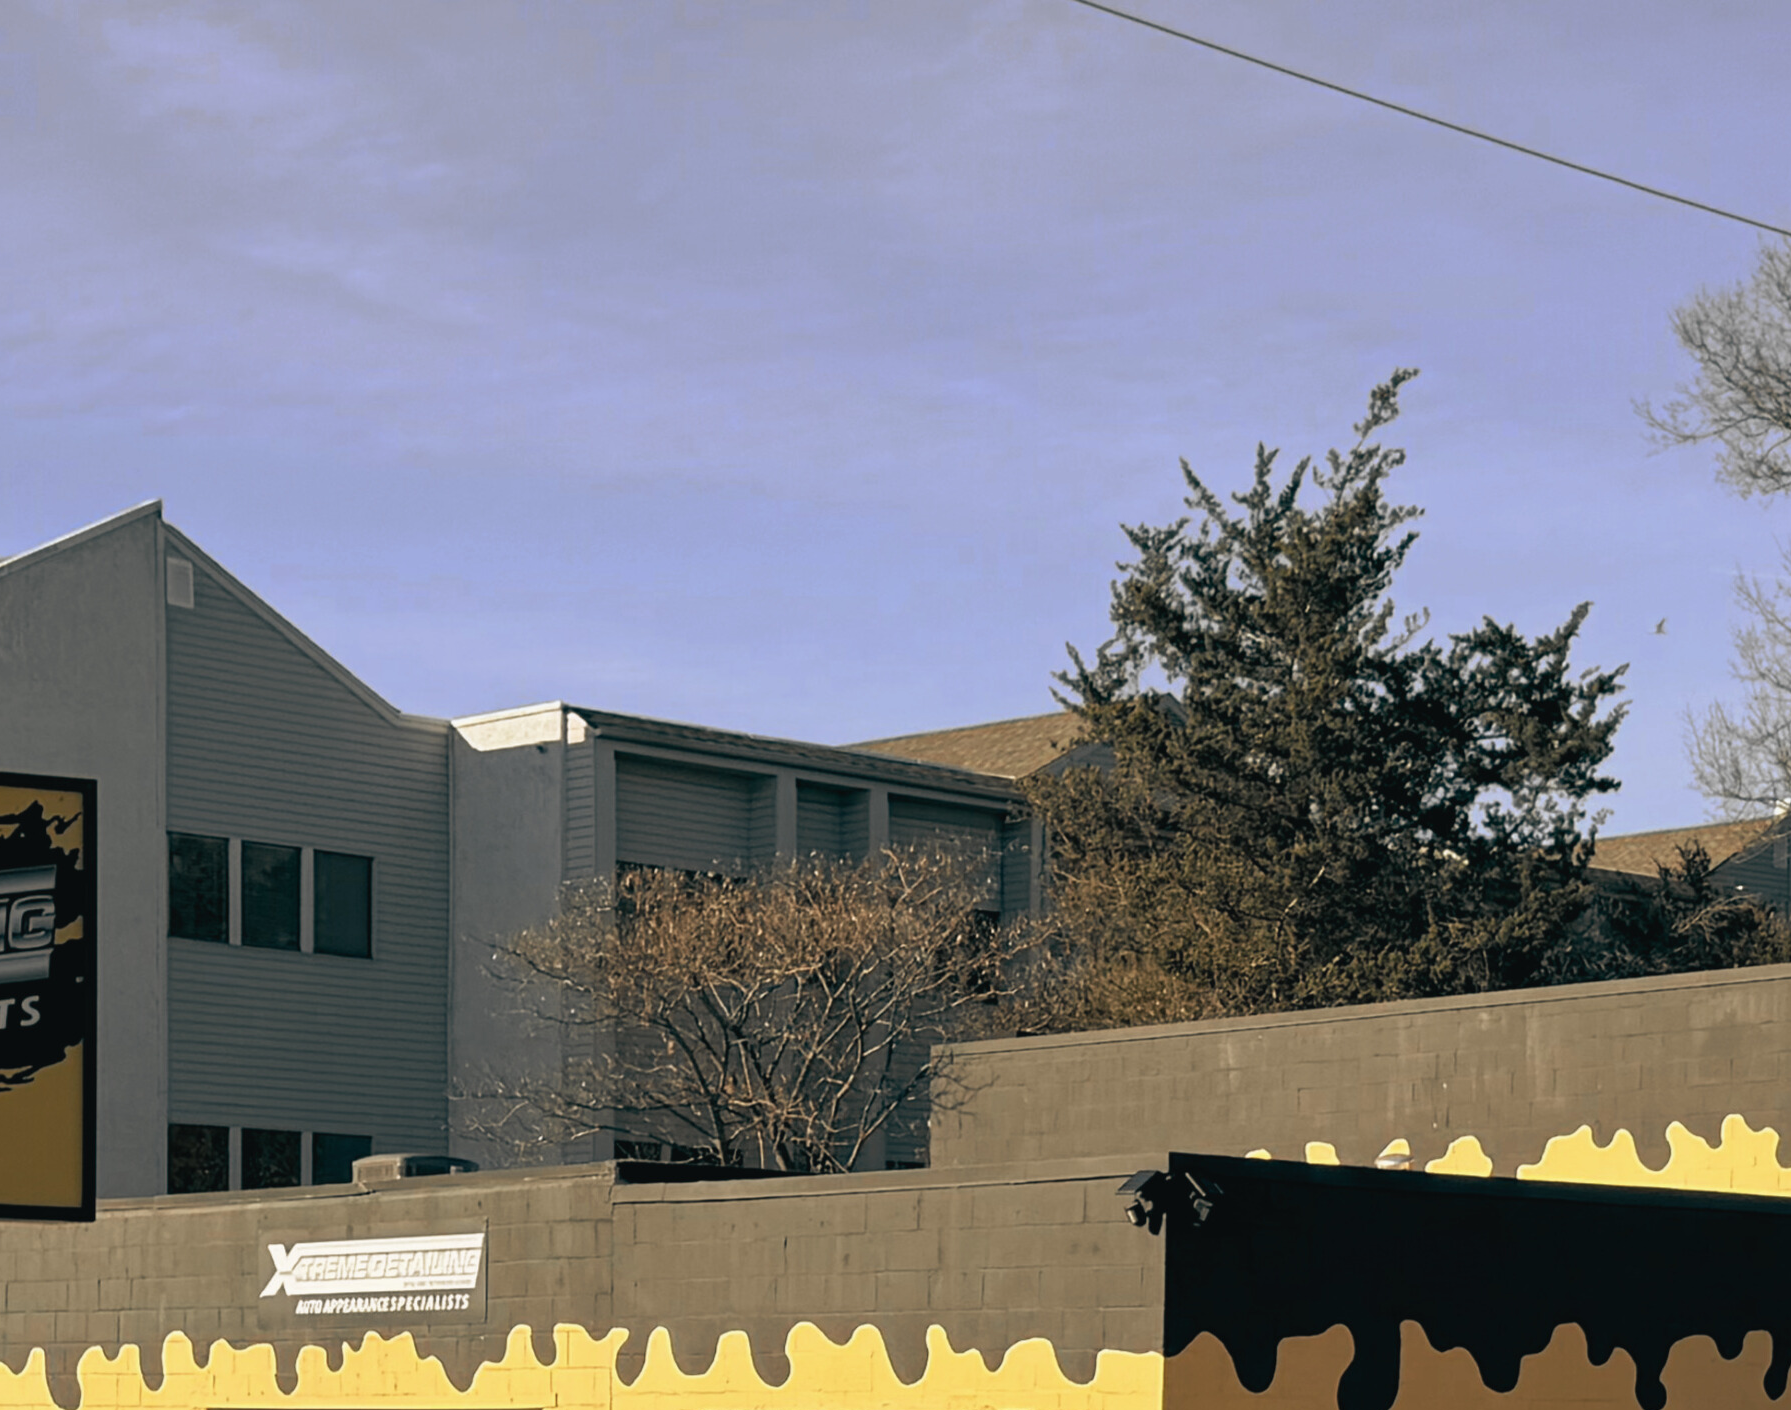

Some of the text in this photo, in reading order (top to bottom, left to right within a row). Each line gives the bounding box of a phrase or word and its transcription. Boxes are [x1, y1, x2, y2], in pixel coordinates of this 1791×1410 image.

[259, 1243, 482, 1298] XTREME DETAILING
[295, 1294, 470, 1314] AUTO APPEARANCE SPECIALISTS
